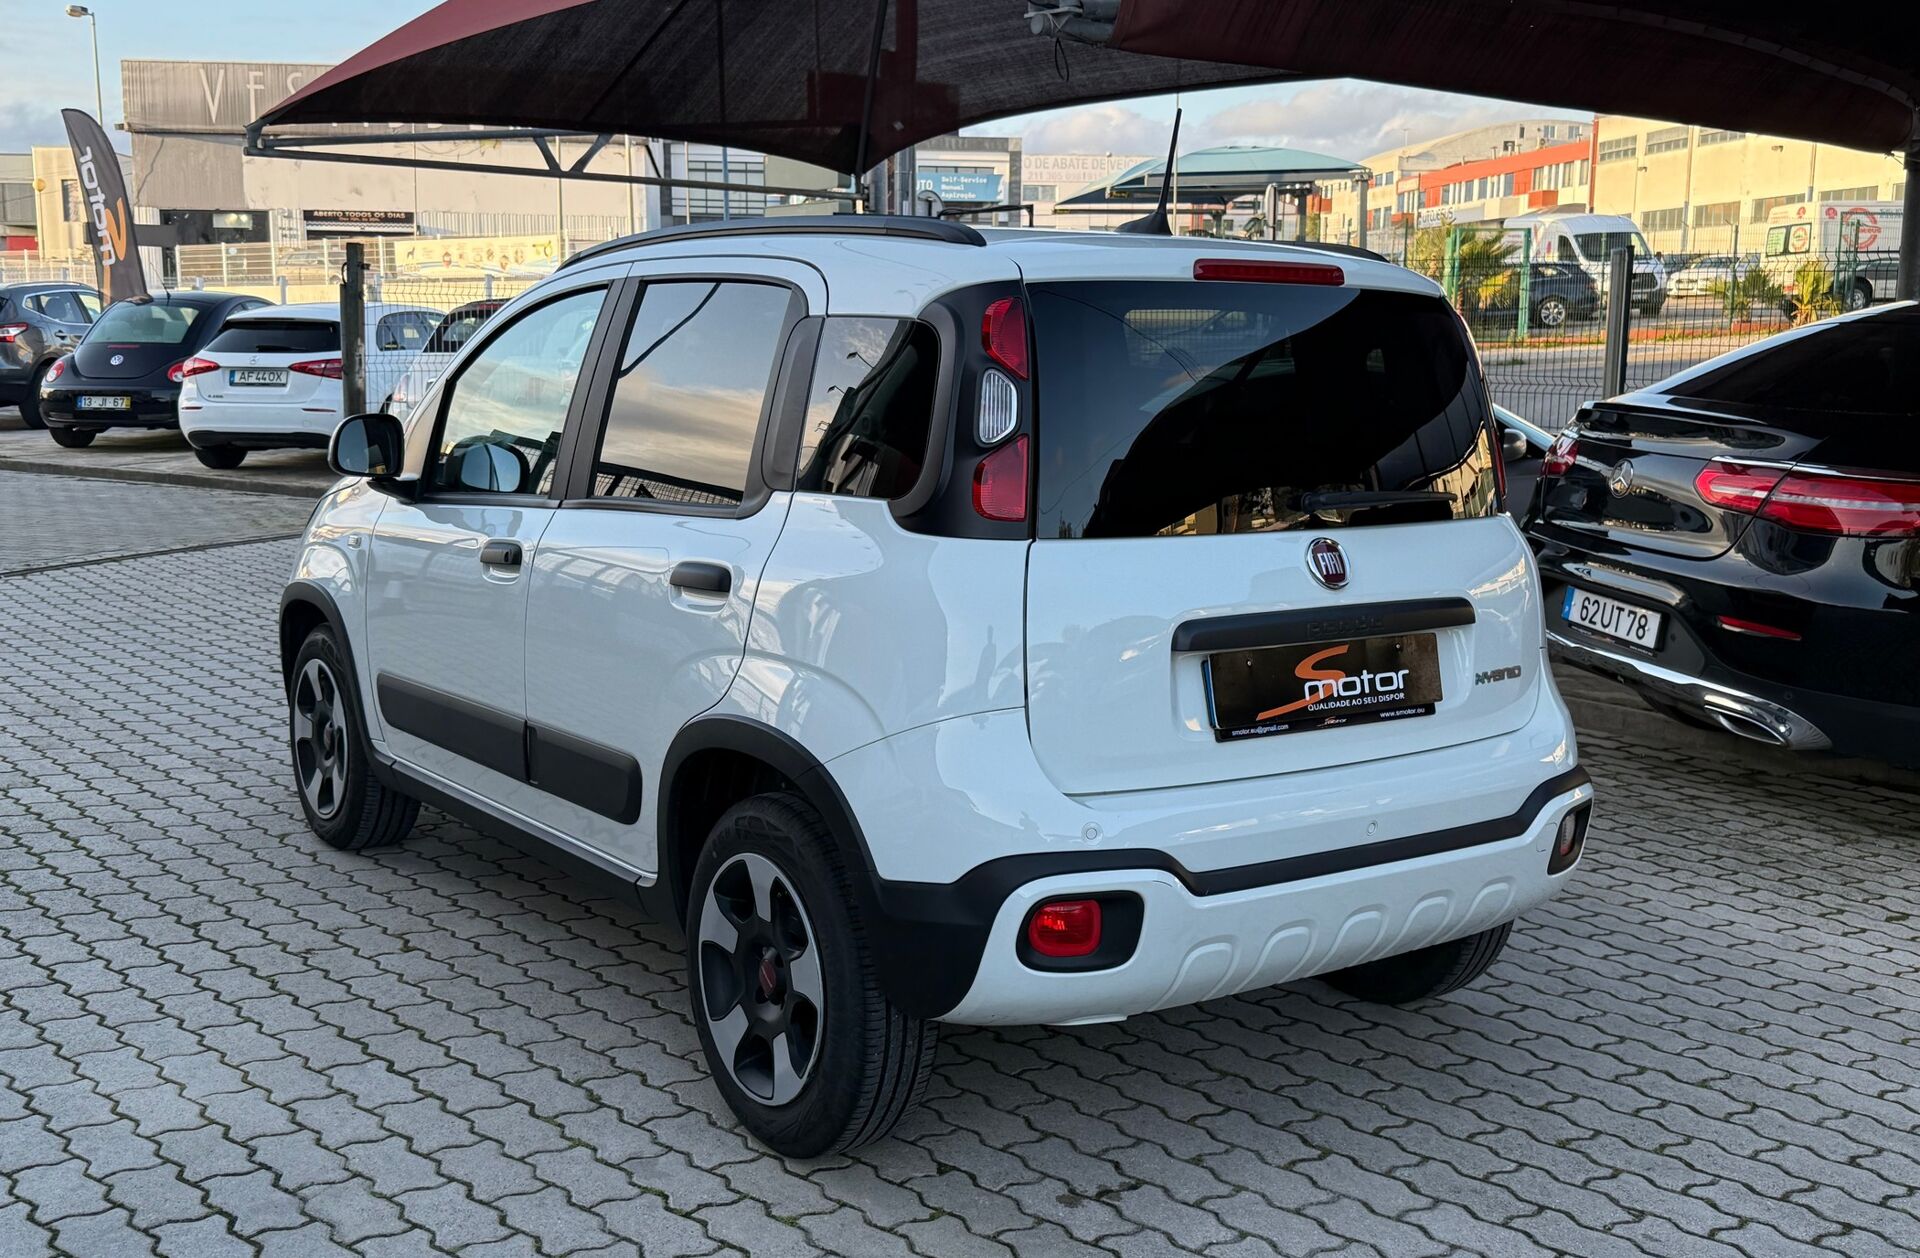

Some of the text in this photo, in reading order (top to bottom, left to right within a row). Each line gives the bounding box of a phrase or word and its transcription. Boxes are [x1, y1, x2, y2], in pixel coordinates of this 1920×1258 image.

[1035, 157, 1050, 169] DE
[1052, 157, 1088, 170] ABATE
[1091, 158, 1105, 170] DE
[941, 176, 987, 184] Self-Service
[1319, 551, 1343, 575] FIAT
[1580, 597, 1648, 640] 62UT78
[1307, 693, 1405, 711] QUALIDADE AO SEU DISPOR
[1380, 707, 1425, 719] www.smotor.eu
[1232, 724, 1289, 737] smotor.eu@gmail.com
